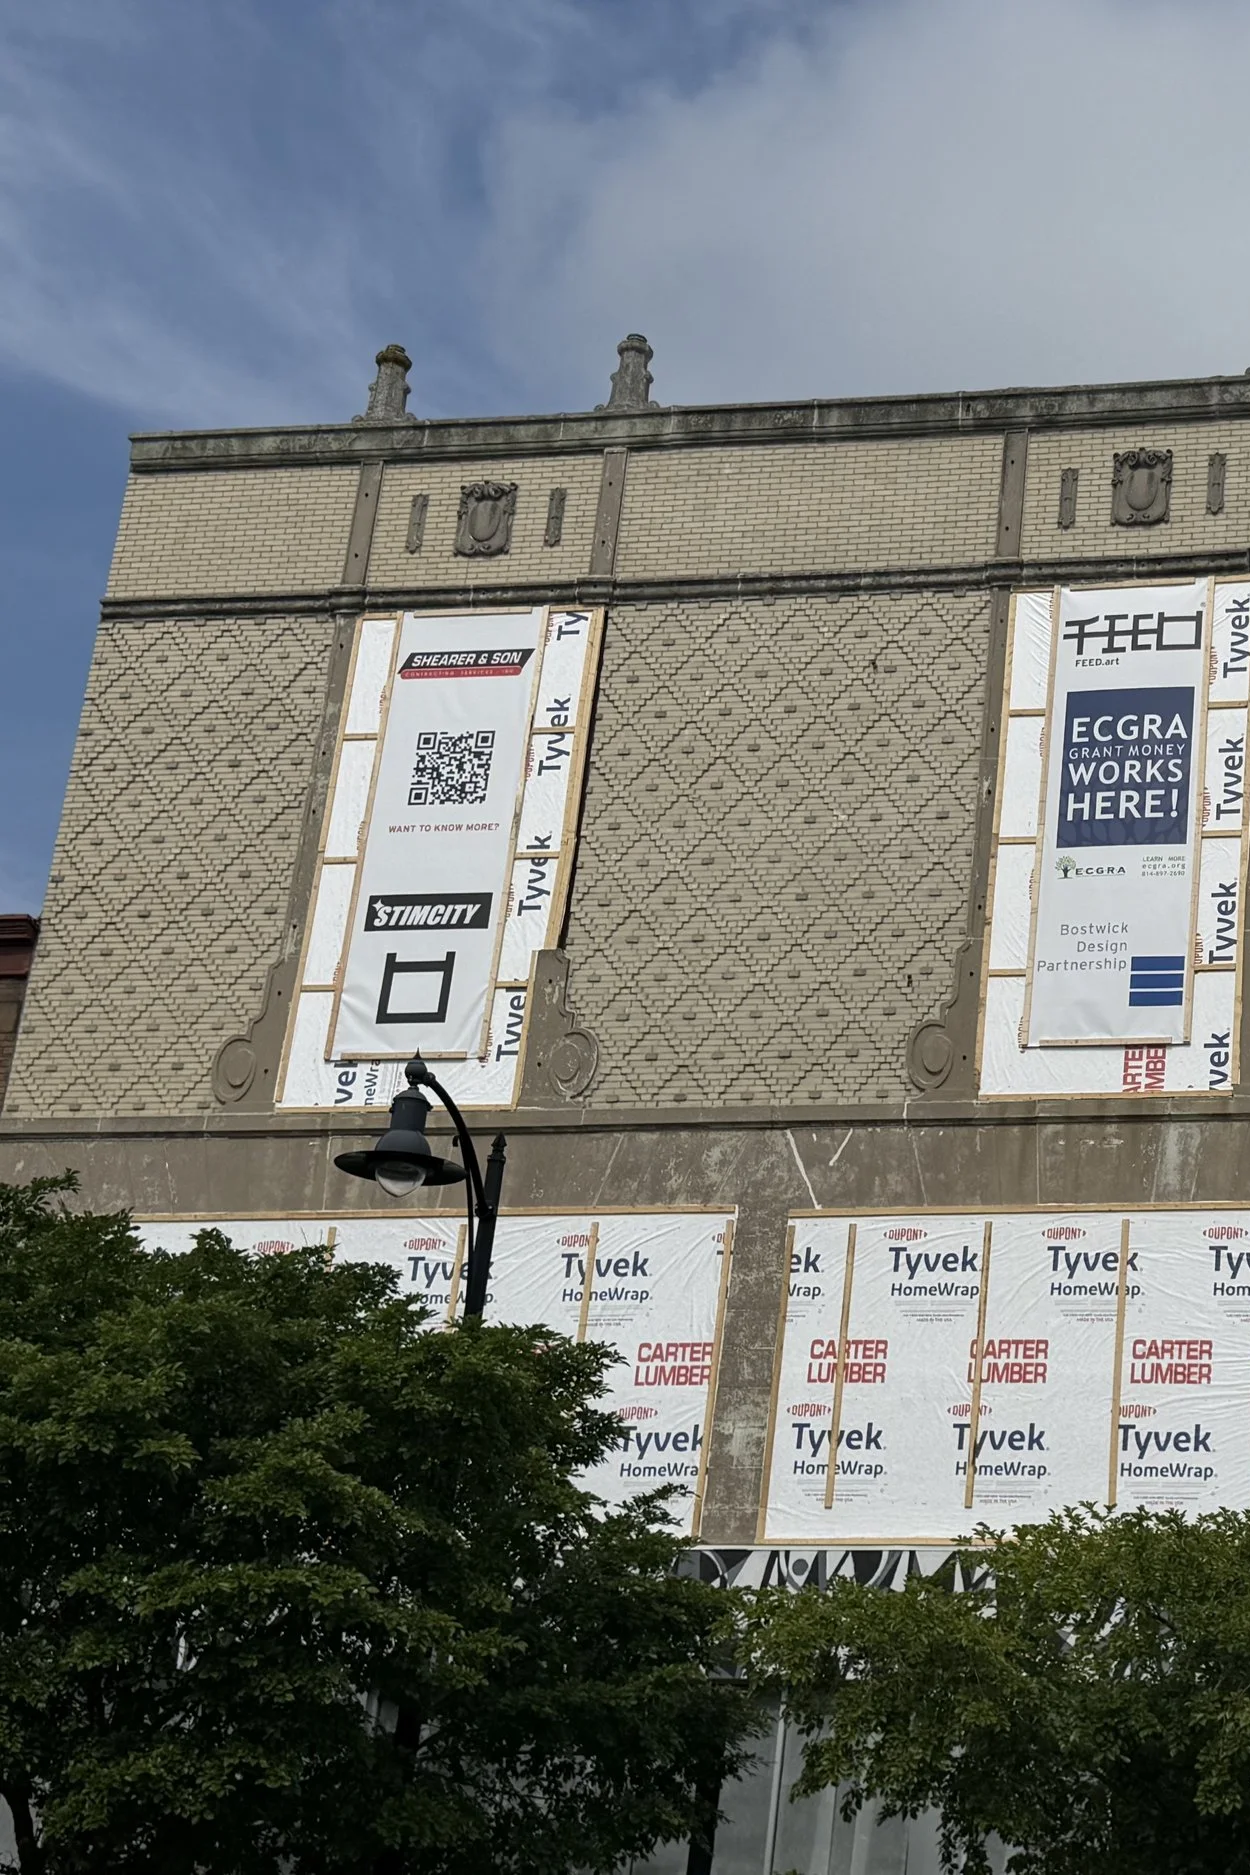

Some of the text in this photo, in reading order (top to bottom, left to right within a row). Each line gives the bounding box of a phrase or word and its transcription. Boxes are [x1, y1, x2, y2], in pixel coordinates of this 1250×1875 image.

[1223, 598, 1250, 678] Tyvek
[411, 651, 522, 667] SHEARER & SON
[1075, 657, 1120, 667] FEED.art
[537, 697, 571, 776] Tyvek
[1071, 712, 1188, 743] ECGRA
[1069, 743, 1186, 760] GRANT MONEY
[1068, 758, 1183, 786] WORKS
[1216, 738, 1244, 820] Tyvek
[1066, 789, 1179, 822] HERE!
[388, 823, 499, 833] WANT TO KNOW MORE?
[517, 835, 552, 916] Tyvek
[373, 903, 481, 927] STIMCITY
[1208, 882, 1237, 964] Tyvek
[1060, 922, 1129, 936] Bostwick
[1077, 940, 1128, 955] Design
[1037, 957, 1127, 973] Partnership
[1203, 1032, 1230, 1089] vek
[561, 1234, 591, 1248] DUPON
[888, 1227, 923, 1241] DUPONT
[1047, 1227, 1082, 1240] DUPONT
[1208, 1226, 1243, 1240] DUPONT
[408, 1238, 441, 1250] DUPONT
[889, 1246, 978, 1280] Tyvek
[891, 1282, 979, 1299] HomeWrap
[637, 1342, 714, 1362] CARTER
[1132, 1339, 1213, 1360] CARTER
[634, 1365, 712, 1386] LUMBER
[1130, 1362, 1212, 1385] LUMBER
[792, 1403, 826, 1417] DUPONT
[952, 1404, 988, 1418] DUPNT
[792, 1422, 883, 1457] Tyvek
[953, 1423, 1046, 1458] Tyvek
[1118, 1424, 1212, 1459] Tyvek
[619, 1462, 699, 1478] HomeWra
[1120, 1463, 1213, 1481] HomeWrap
